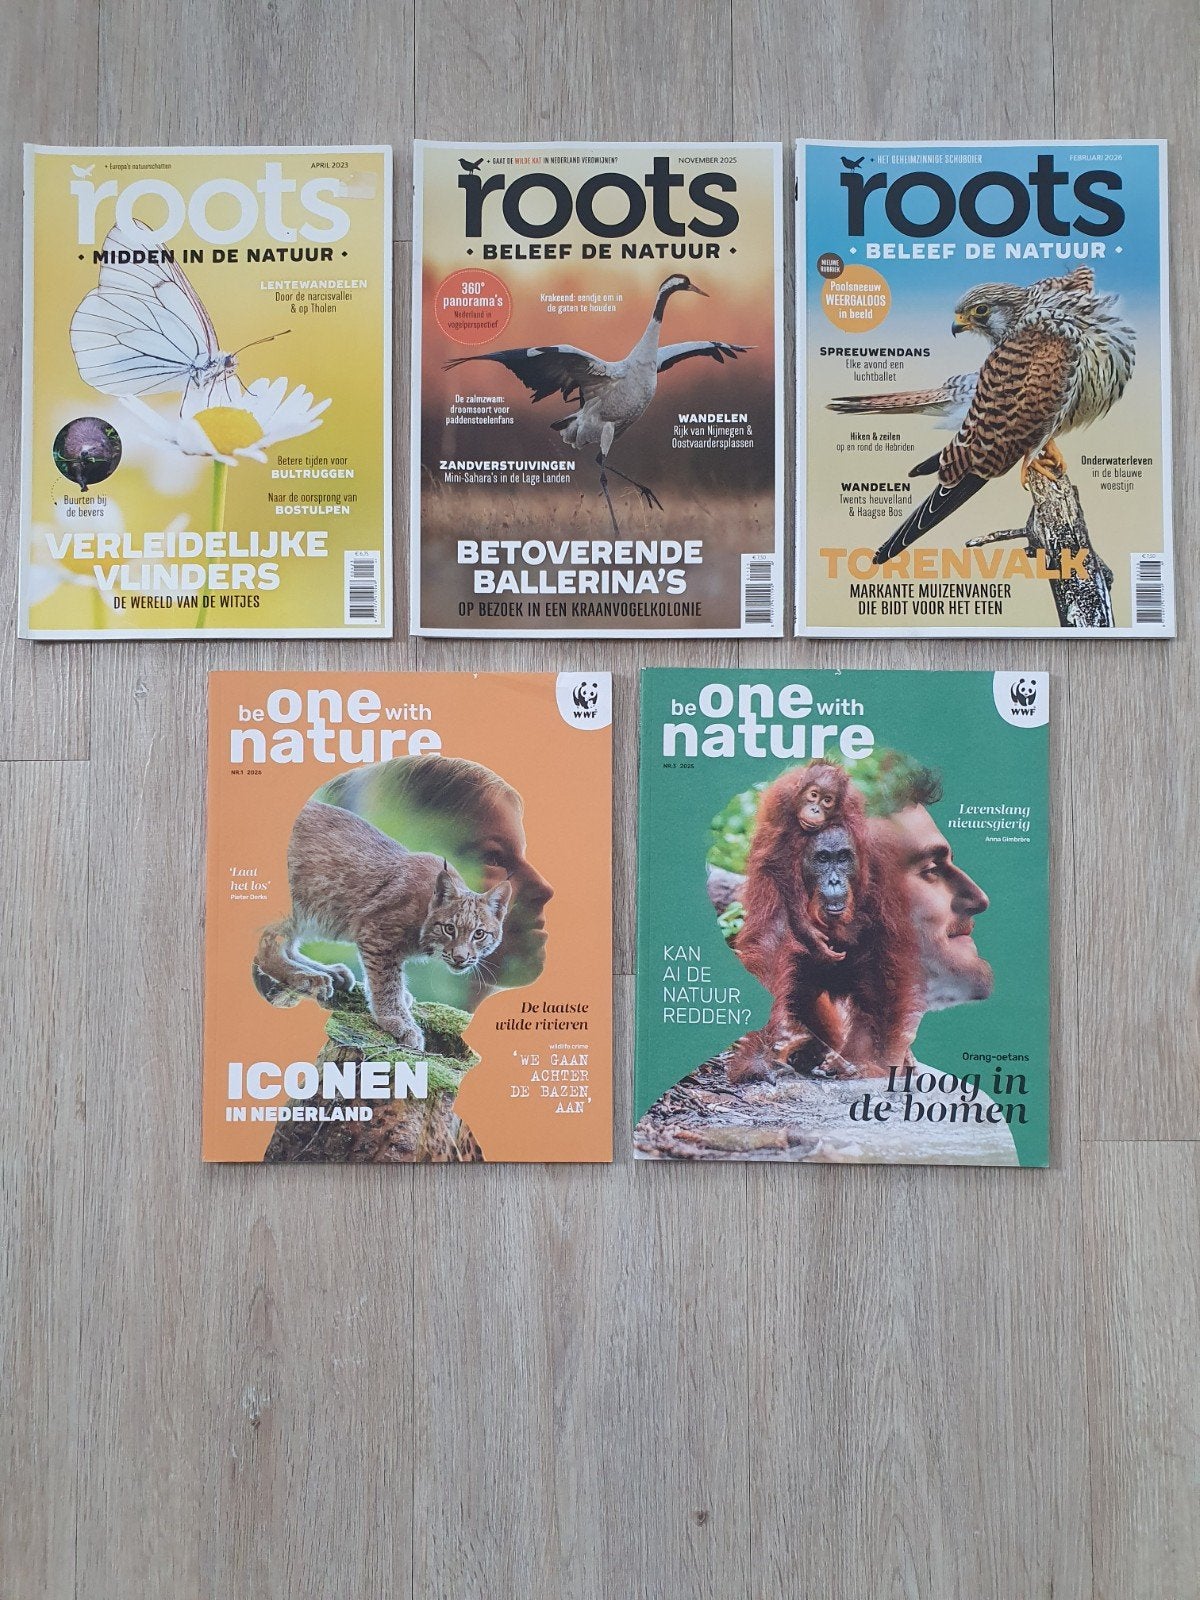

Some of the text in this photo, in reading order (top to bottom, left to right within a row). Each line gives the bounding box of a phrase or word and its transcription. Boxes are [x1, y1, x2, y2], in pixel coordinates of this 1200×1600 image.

[877, 155, 889, 164] HET
[458, 156, 740, 238] roots
[840, 155, 1125, 238] roots
[70, 162, 350, 244] roots
[93, 248, 333, 264] MIDDEN IN DE NATUUR
[483, 244, 720, 260] BELEEF DE NATUUR
[866, 243, 1106, 259] BELEEF DE NATUUR
[261, 280, 367, 290] LENTEWANDELEN
[462, 282, 485, 295] 360°
[830, 281, 881, 292] Poolsneeuw
[275, 291, 352, 302] Door de narcisvallei
[443, 294, 503, 309] panorama's
[826, 294, 886, 306] WEERGALOOS
[290, 304, 336, 315] & op Tholen
[839, 309, 872, 318] in beeld
[820, 347, 930, 357] SPREEUWENDANS
[846, 359, 904, 370] Elke avond een
[854, 372, 896, 382] luchtballet
[455, 394, 505, 403] De zalmzwam:
[450, 405, 510, 414] droomsoort voor
[446, 416, 514, 426] paddenstoelenfans
[678, 414, 748, 423] WANDELEN
[673, 425, 753, 438] Rijk van Nijmegen &
[850, 432, 900, 440] Hiken & zeilen
[672, 437, 754, 450] Oostvaardersplassen
[837, 444, 844, 453] op
[858, 443, 873, 452] rond
[875, 443, 883, 452] de
[886, 443, 914, 452] Hebriden
[277, 455, 348, 468] Betere tijden voor
[440, 460, 576, 471] ZANDVERSTUIVINGEN
[1082, 456, 1152, 466] Onderwaterleven
[272, 470, 354, 479] BULTRUGGEN
[444, 472, 570, 484] Mini-Sahara's in de Lage Landen
[1092, 468, 1142, 478] in de blauwe
[842, 483, 910, 492] WANDELEN
[1100, 481, 1134, 492] woestijn
[64, 495, 107, 507] Buurten bij
[268, 493, 357, 505] Naar de oorsprong van
[840, 494, 912, 505] Twents heuvelland
[66, 507, 104, 517] de bevers
[276, 506, 350, 515] BOSTULPEN
[849, 507, 902, 519] & Haagse Bos
[45, 531, 329, 559] VERLEIDELIJKE
[457, 540, 703, 565] BETOVERENDE
[820, 548, 1092, 580] TORENVALK
[93, 563, 280, 591] VLINDERS
[474, 570, 687, 594] BALLERINA'S
[850, 584, 1010, 598] MARKANTE MUIZENVANGER
[114, 595, 260, 609] DE WERELD VAN DE WITJES
[858, 600, 1002, 615] DIE BIDT VOOR HET ETEN
[458, 602, 702, 617] OP BEZOEK IN EEN KRAANVOGELKOLONIE
[239, 688, 432, 723] be one with
[672, 683, 864, 718] be one with
[574, 711, 598, 719] WWF
[230, 718, 442, 763] nature
[663, 713, 874, 758] nature
[960, 804, 1030, 818] Levenslang
[948, 818, 1030, 832] nieuwsgierig
[230, 880, 248, 890] het
[664, 945, 700, 961] KAN
[663, 967, 711, 982] AI DE
[664, 986, 740, 1004] NATUUR
[521, 1002, 588, 1014] De laatste
[664, 1008, 751, 1024] REDDEN?
[496, 1019, 588, 1030] wilde rivieren
[550, 1054, 588, 1066] GAAN
[962, 1052, 1030, 1063] Orang-oetans
[228, 1062, 428, 1100] ICONEN
[530, 1070, 589, 1082] ACHTER
[884, 1066, 1029, 1102] Hoog in
[510, 1086, 530, 1098] DE
[226, 1107, 372, 1122] IN NEDERLAND
[849, 1094, 1029, 1124] de bomen
